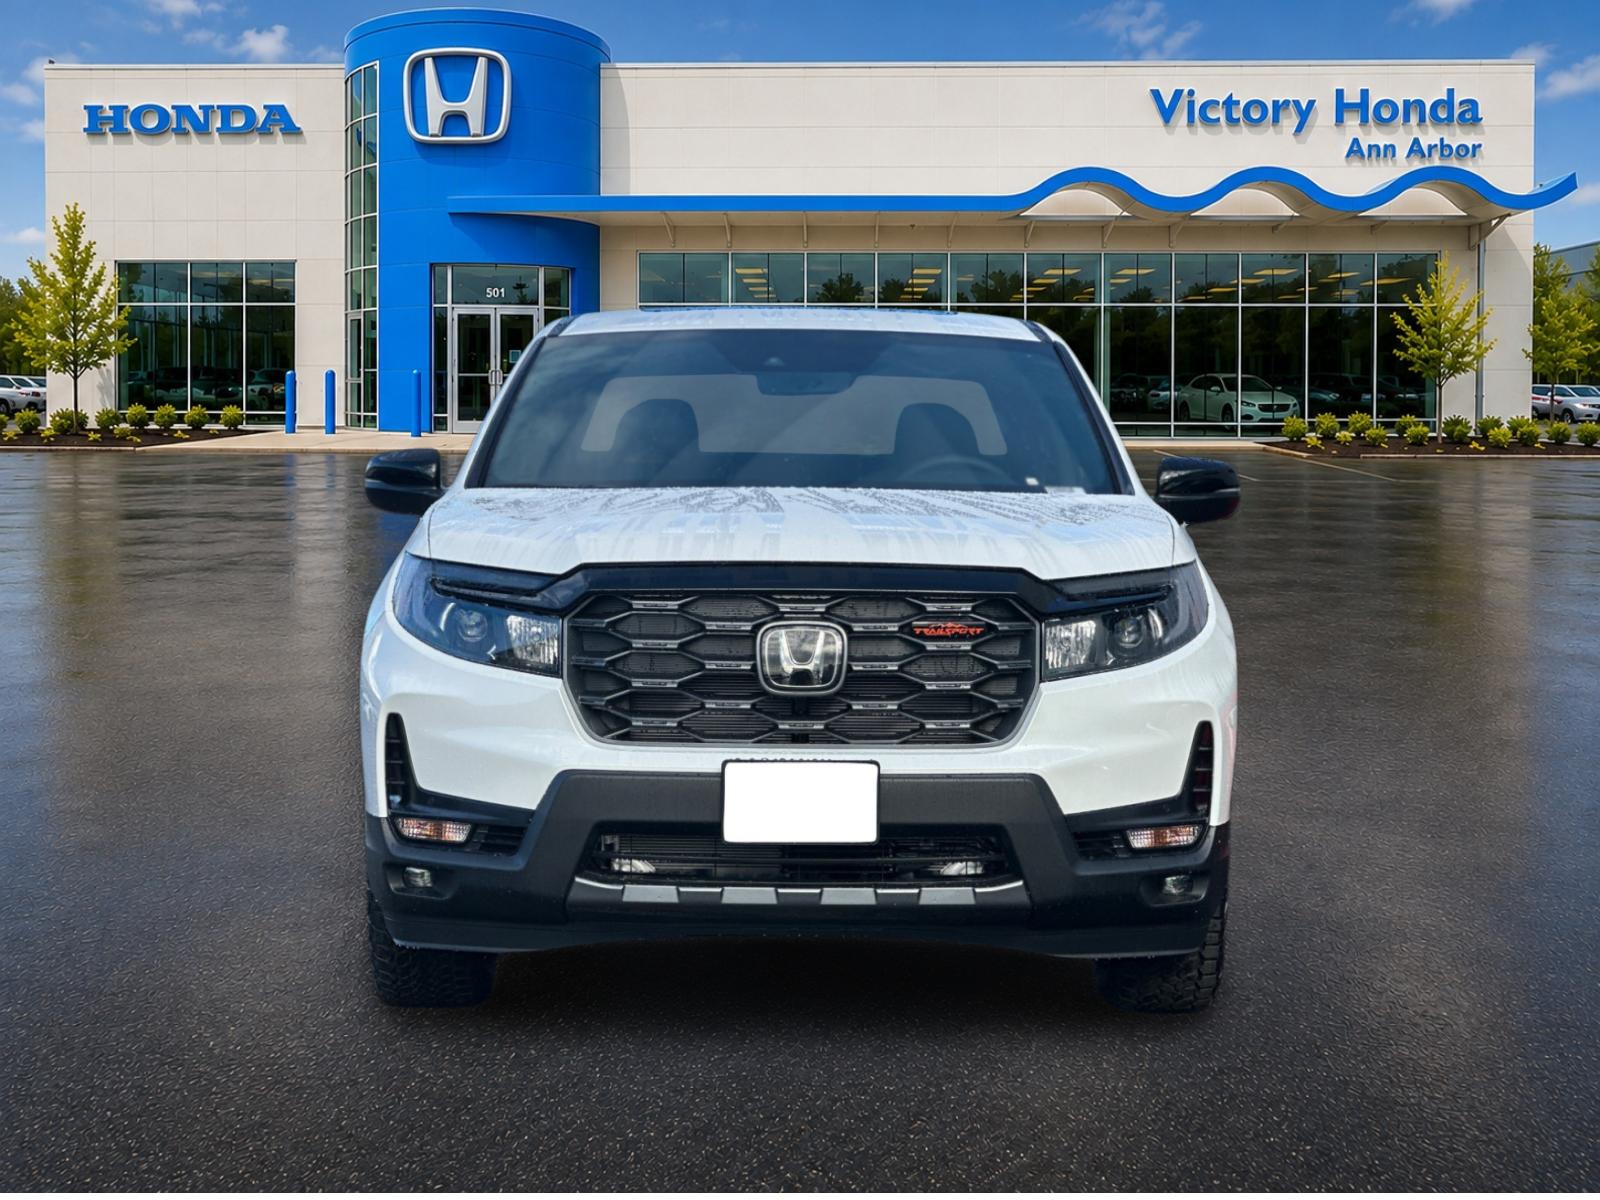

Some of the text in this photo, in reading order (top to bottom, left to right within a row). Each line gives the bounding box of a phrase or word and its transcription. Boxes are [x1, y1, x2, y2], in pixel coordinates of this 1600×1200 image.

[83, 103, 301, 135] HONDA
[1150, 87, 1483, 136] Victory Honda
[1345, 137, 1483, 159] Ann Arbor
[485, 287, 505, 298] 501
[912, 627, 985, 637] TRAILSPORT
